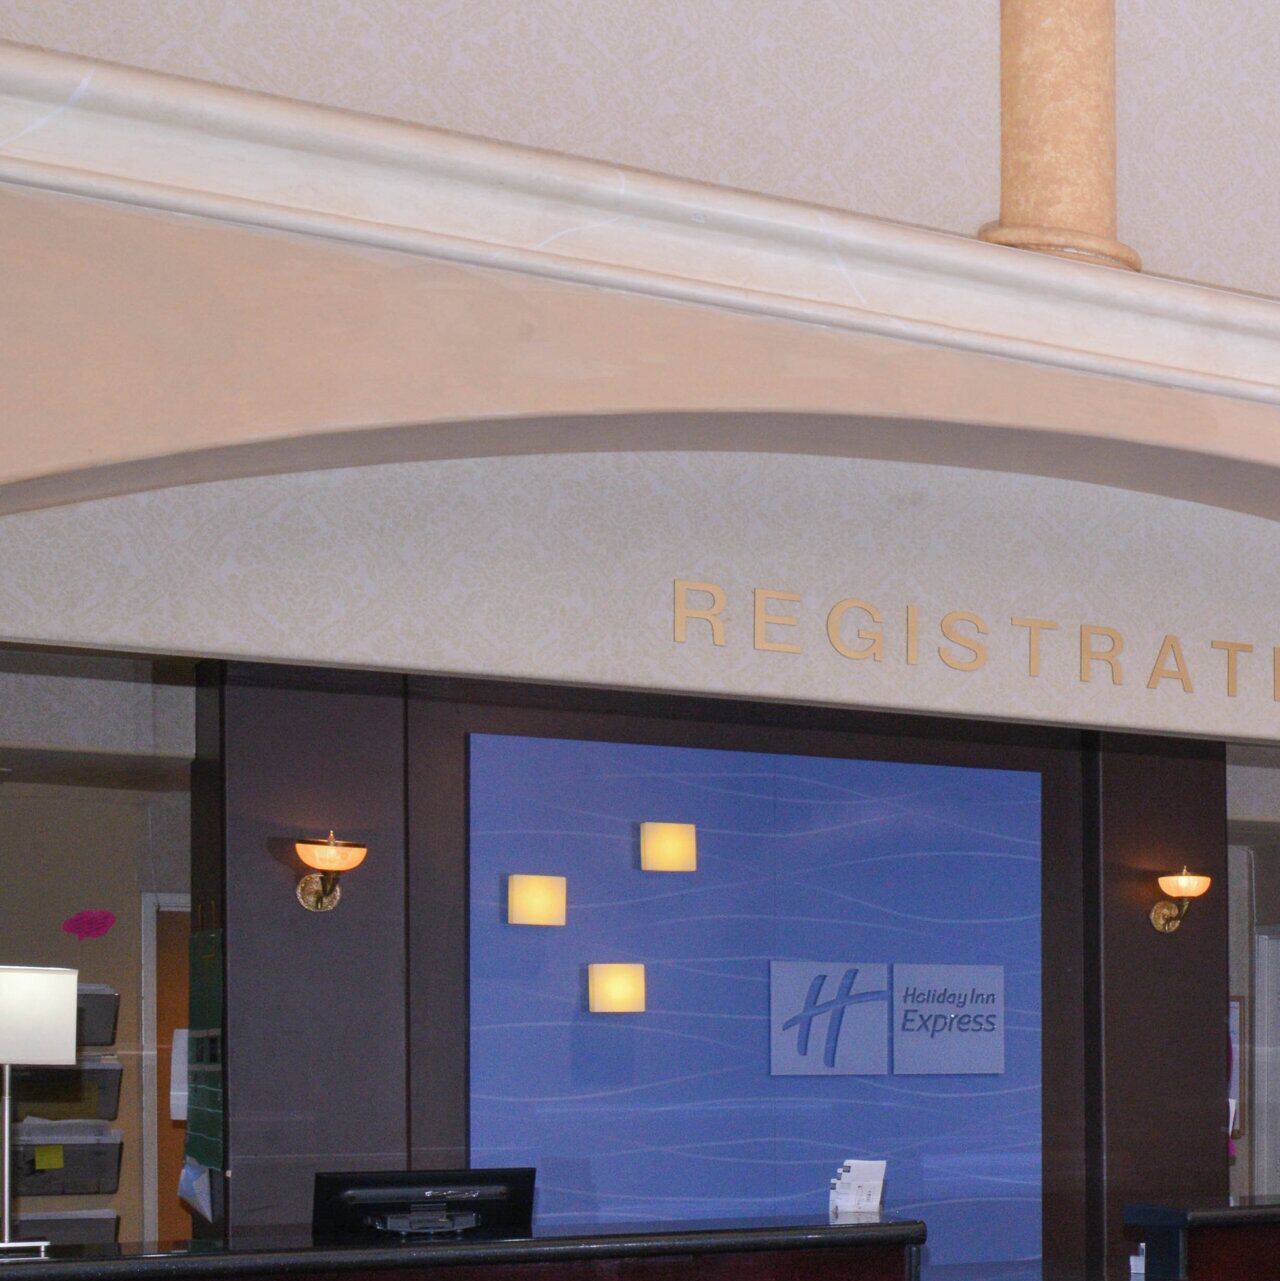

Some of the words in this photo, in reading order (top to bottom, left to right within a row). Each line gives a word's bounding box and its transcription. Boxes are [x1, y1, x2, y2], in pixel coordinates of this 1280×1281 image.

[902, 987, 967, 1008] Holiday
[970, 988, 996, 1004] Inn
[901, 1009, 997, 1038] Express
